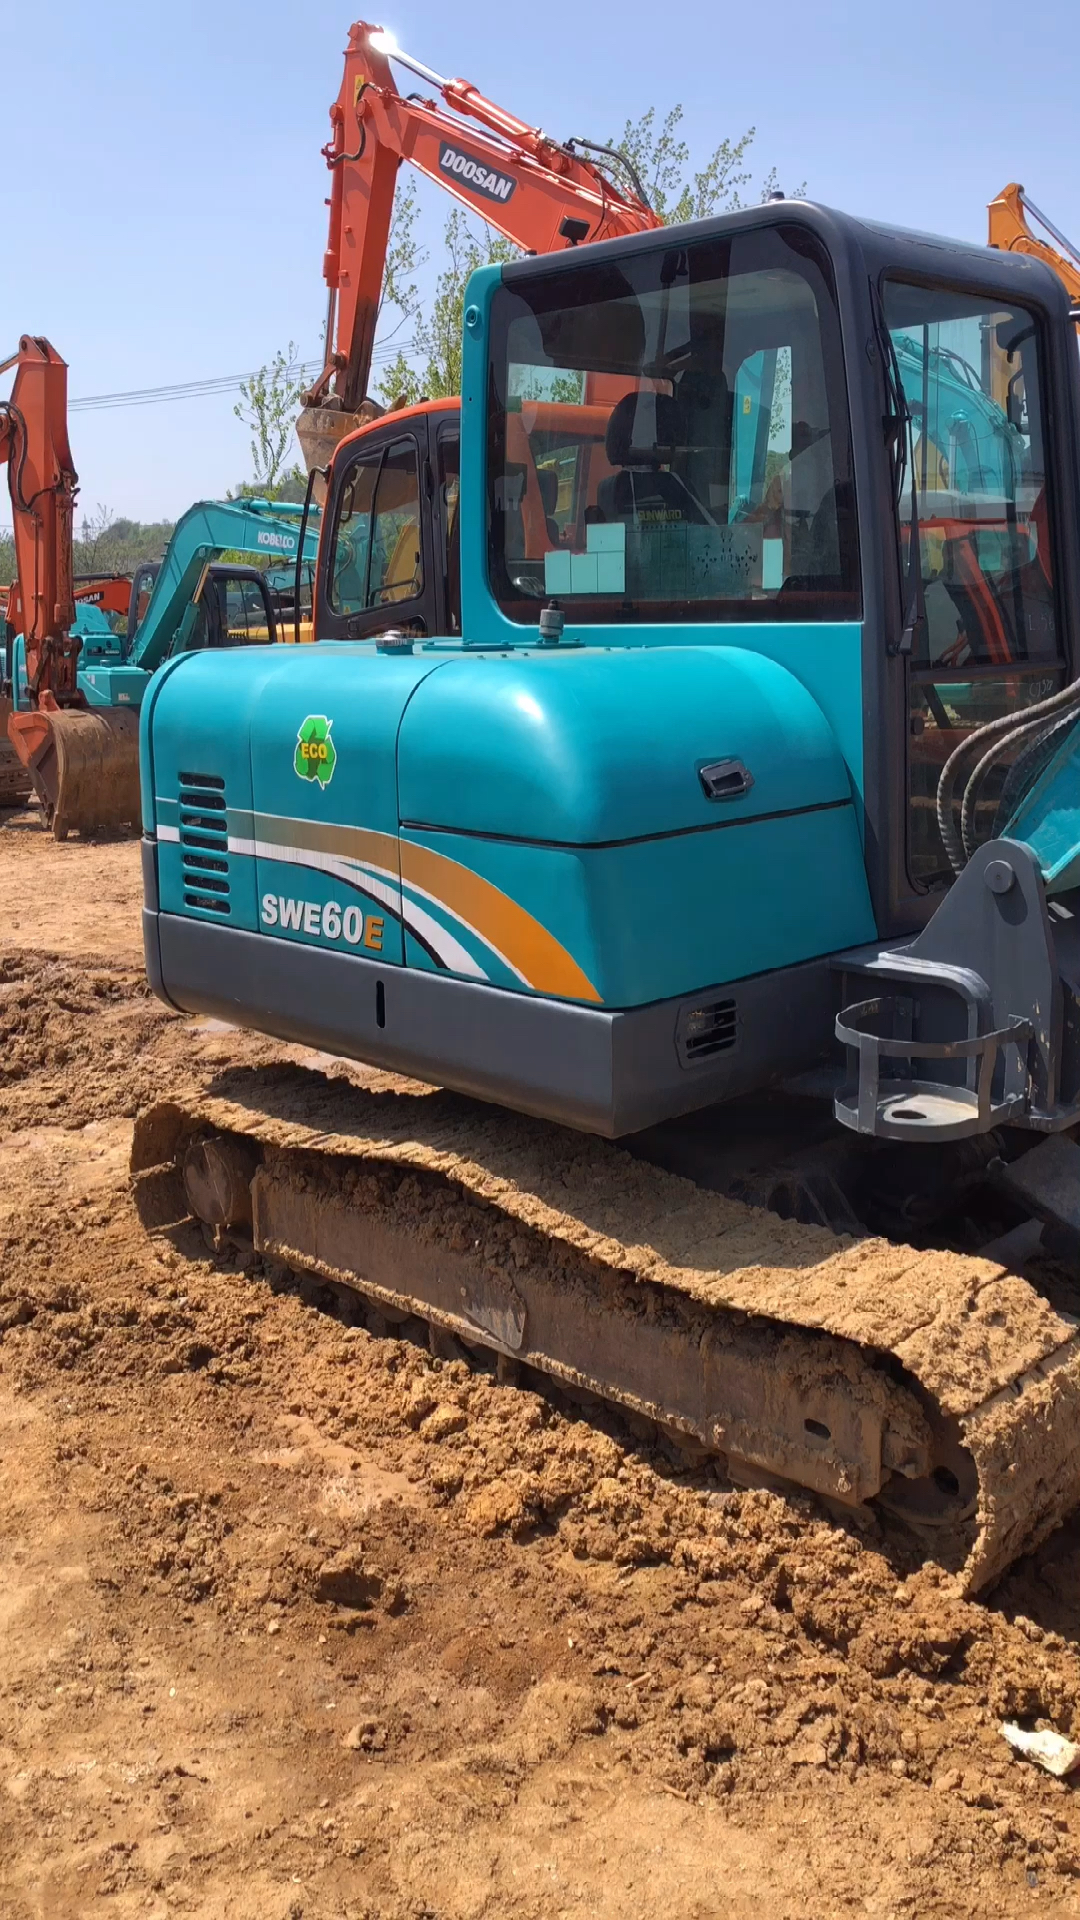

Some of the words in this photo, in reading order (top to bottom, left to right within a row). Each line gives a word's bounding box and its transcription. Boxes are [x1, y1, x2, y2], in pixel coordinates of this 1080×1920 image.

[440, 148, 512, 199] DOOSAN
[638, 509, 682, 521] SUNWARD
[257, 531, 295, 549] KOBELCO
[301, 742, 328, 759] ECO
[261, 893, 384, 951] SWE60E
